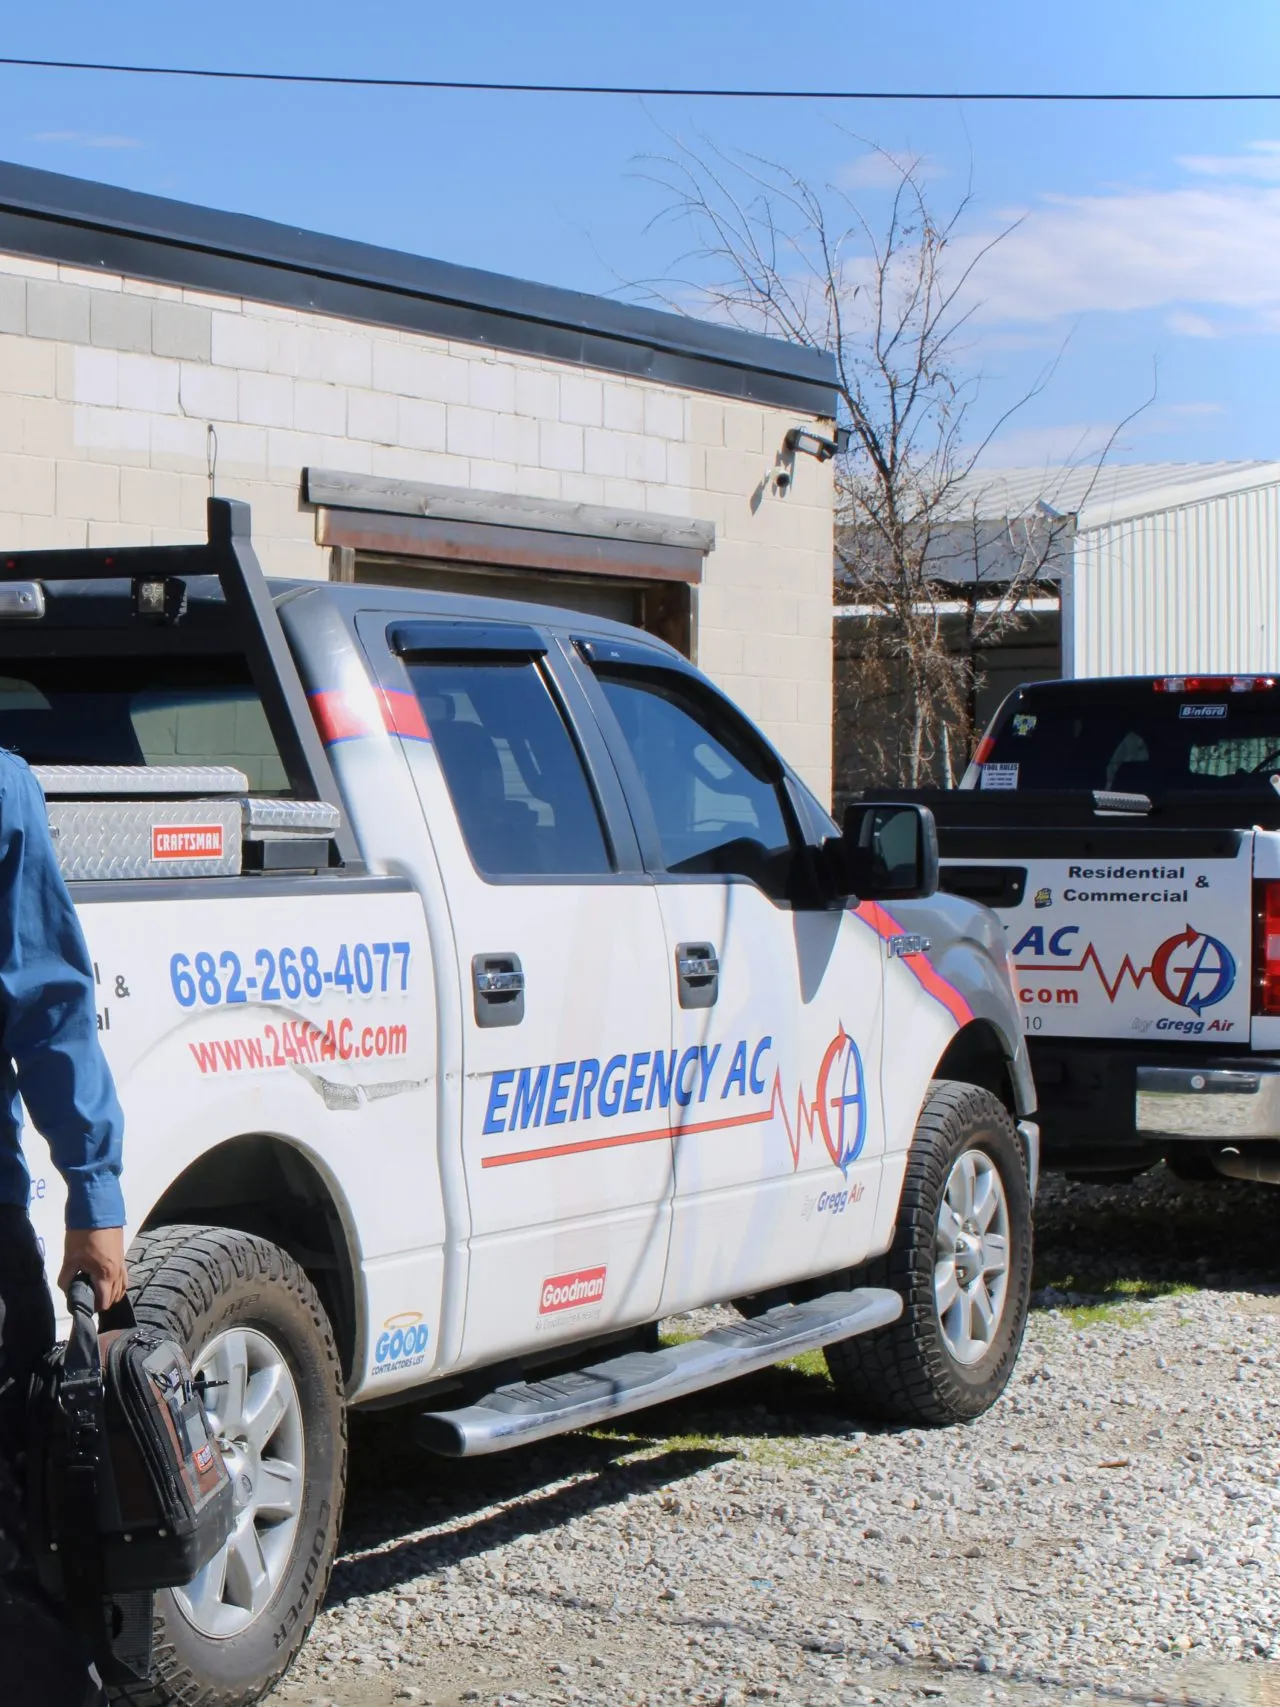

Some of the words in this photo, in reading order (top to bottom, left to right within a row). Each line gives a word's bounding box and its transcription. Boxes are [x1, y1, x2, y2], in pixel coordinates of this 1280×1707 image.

[1182, 706, 1225, 717] Binford
[157, 832, 221, 852] CRAFTSMAN
[1068, 866, 1185, 879] Residential
[1195, 875, 1210, 888] &
[1063, 889, 1188, 902] Commercial
[1013, 926, 1079, 956] AC
[170, 942, 410, 1007] 682-268-4077
[1156, 1018, 1205, 1034] Gregg
[1207, 1020, 1234, 1031] Air
[189, 1017, 407, 1073] www.24HrAC.com
[482, 1044, 721, 1136] EMERGENCY
[720, 1036, 772, 1099] AC
[817, 1191, 849, 1215] Gregg
[848, 1181, 865, 1204] Air
[542, 1278, 604, 1308] Goodman
[375, 1323, 429, 1363] GOOD
[371, 1357, 413, 1376] CONTRACTORS
